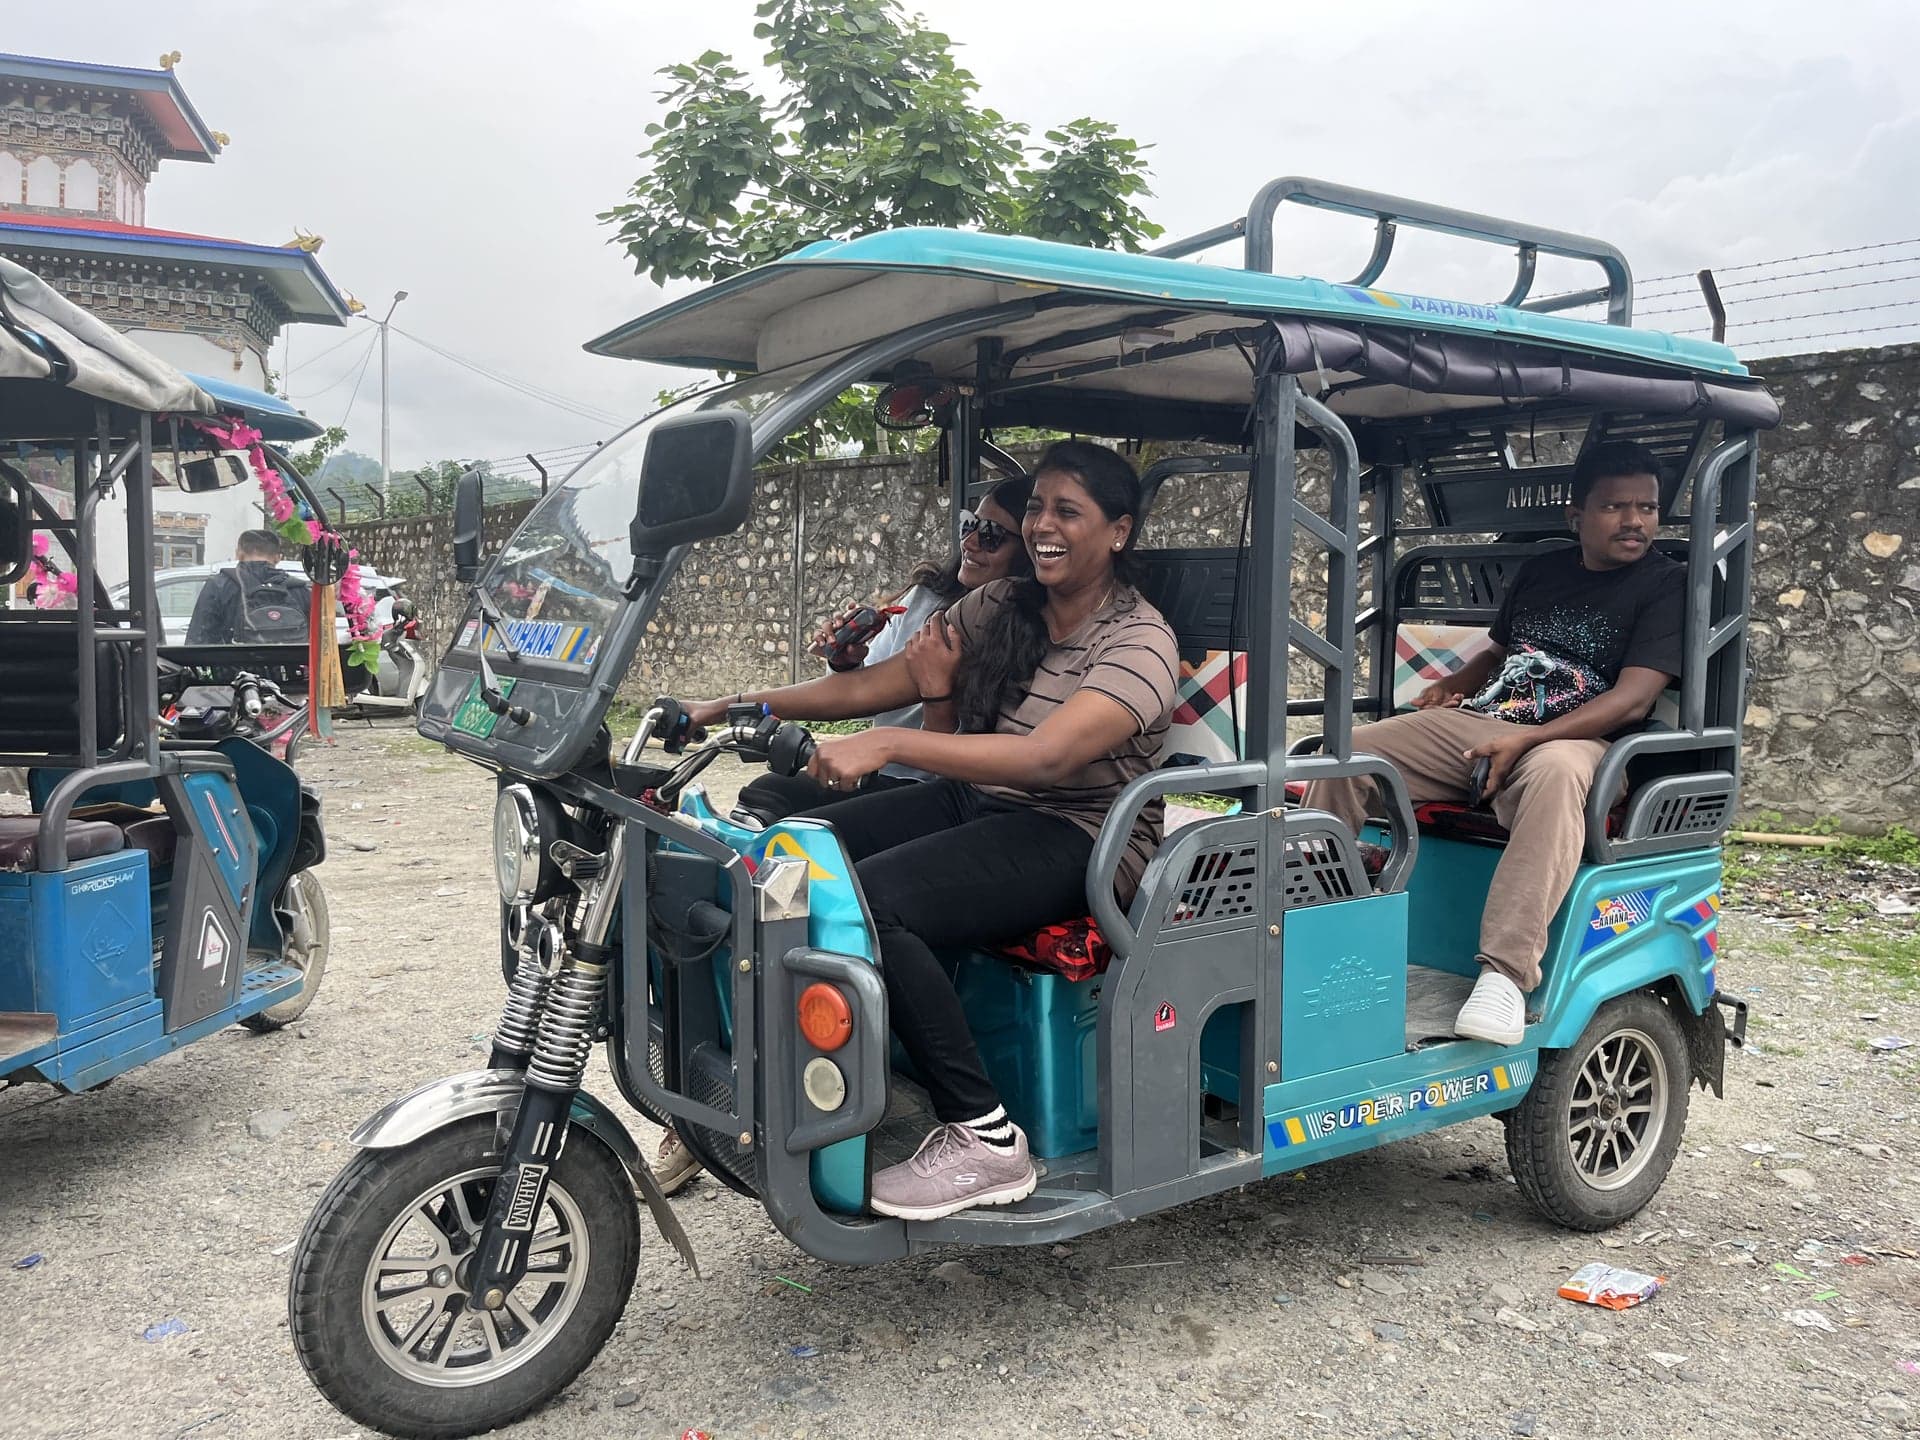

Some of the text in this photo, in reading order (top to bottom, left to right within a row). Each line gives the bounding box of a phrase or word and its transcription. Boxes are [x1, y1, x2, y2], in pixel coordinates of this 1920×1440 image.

[1411, 297, 1498, 322] AAHANA
[1600, 911, 1629, 928] AAHANA
[1321, 1073, 1490, 1133] SUPER POWER
[509, 1168, 541, 1226] AAHANA
